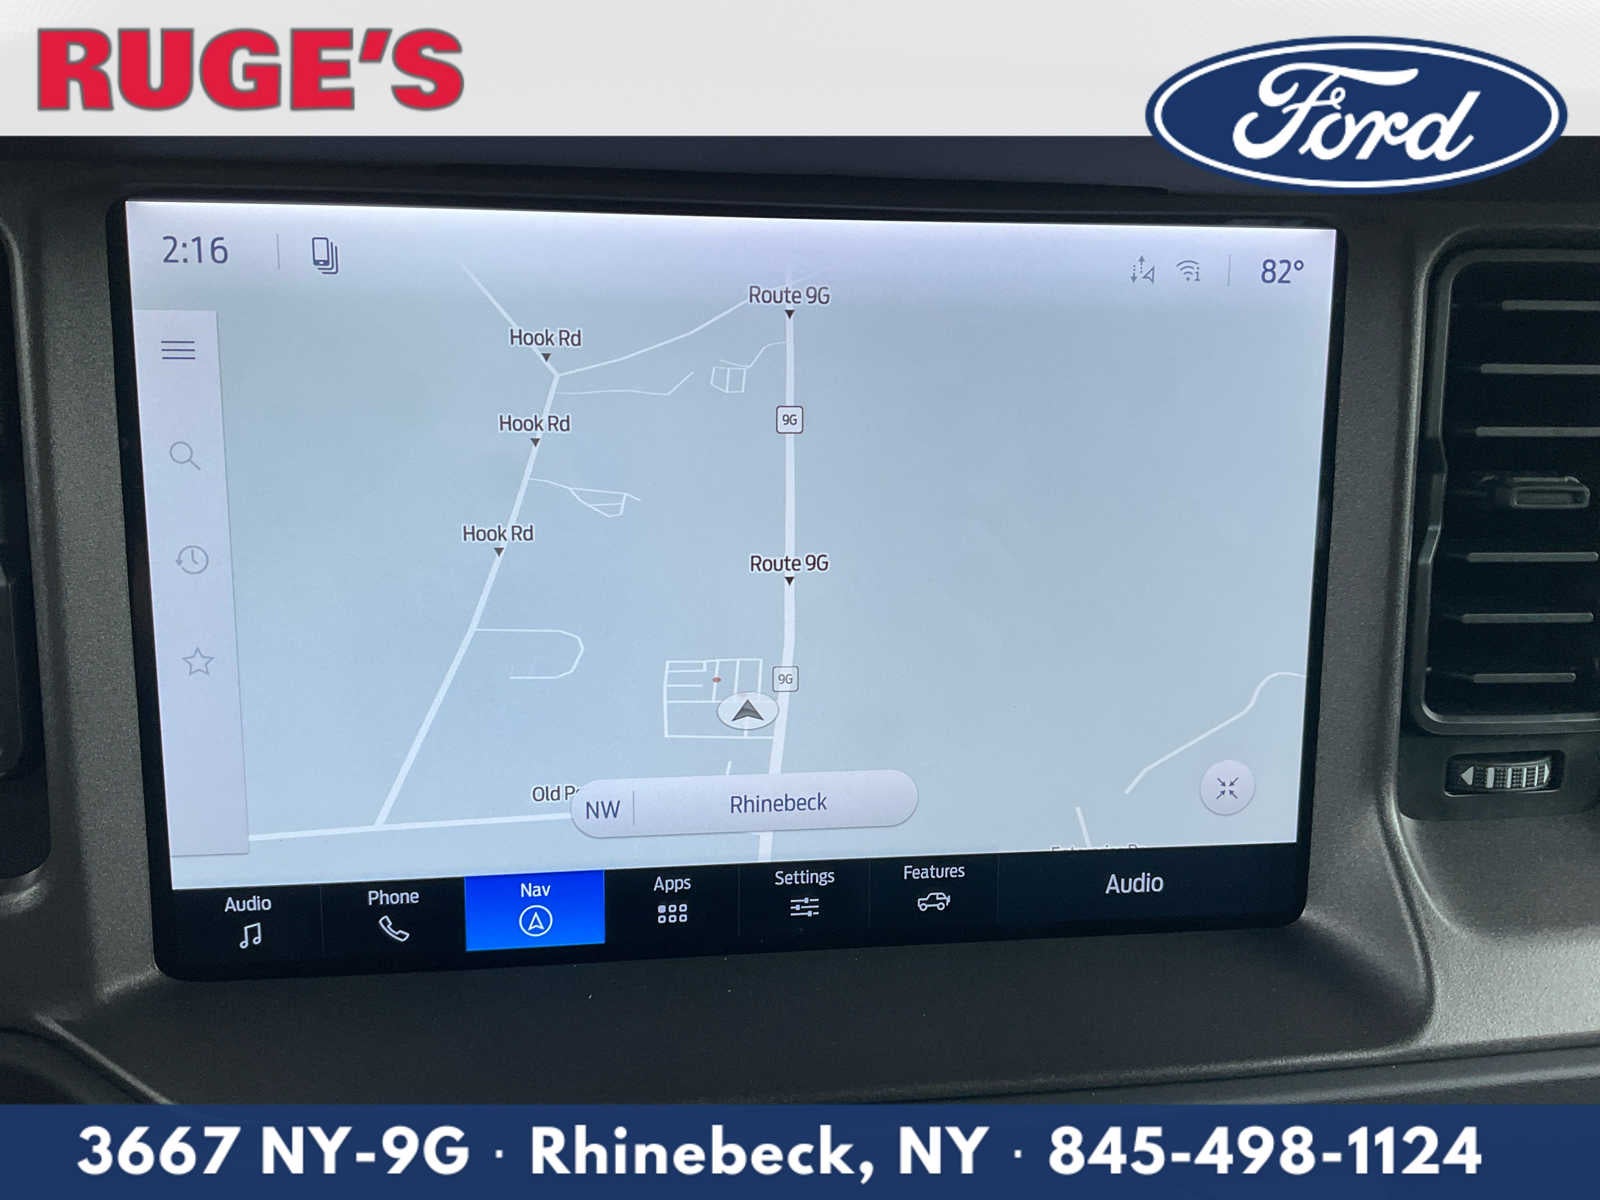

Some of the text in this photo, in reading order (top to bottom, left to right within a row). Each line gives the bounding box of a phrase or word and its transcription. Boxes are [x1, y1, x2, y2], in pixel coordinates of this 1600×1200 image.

[162, 236, 229, 264] 2:16
[1261, 259, 1304, 284] 82°
[749, 286, 830, 305] Route 9G
[510, 329, 582, 347] Hook Rd
[499, 415, 571, 433] Hook Rd
[782, 414, 798, 426] 9G
[463, 525, 534, 542] Hook Rd
[750, 554, 829, 572] Route 9G
[777, 673, 793, 685] 9G
[532, 785, 561, 802] Old
[585, 800, 621, 820] NW
[730, 792, 828, 815] Rhinebeck
[774, 868, 836, 888] Settings
[903, 863, 966, 881] Features
[520, 882, 551, 898] Nav
[653, 875, 692, 893] Apps
[1105, 872, 1165, 895] Audio
[224, 895, 272, 913] Audio
[367, 888, 420, 906] Phone
